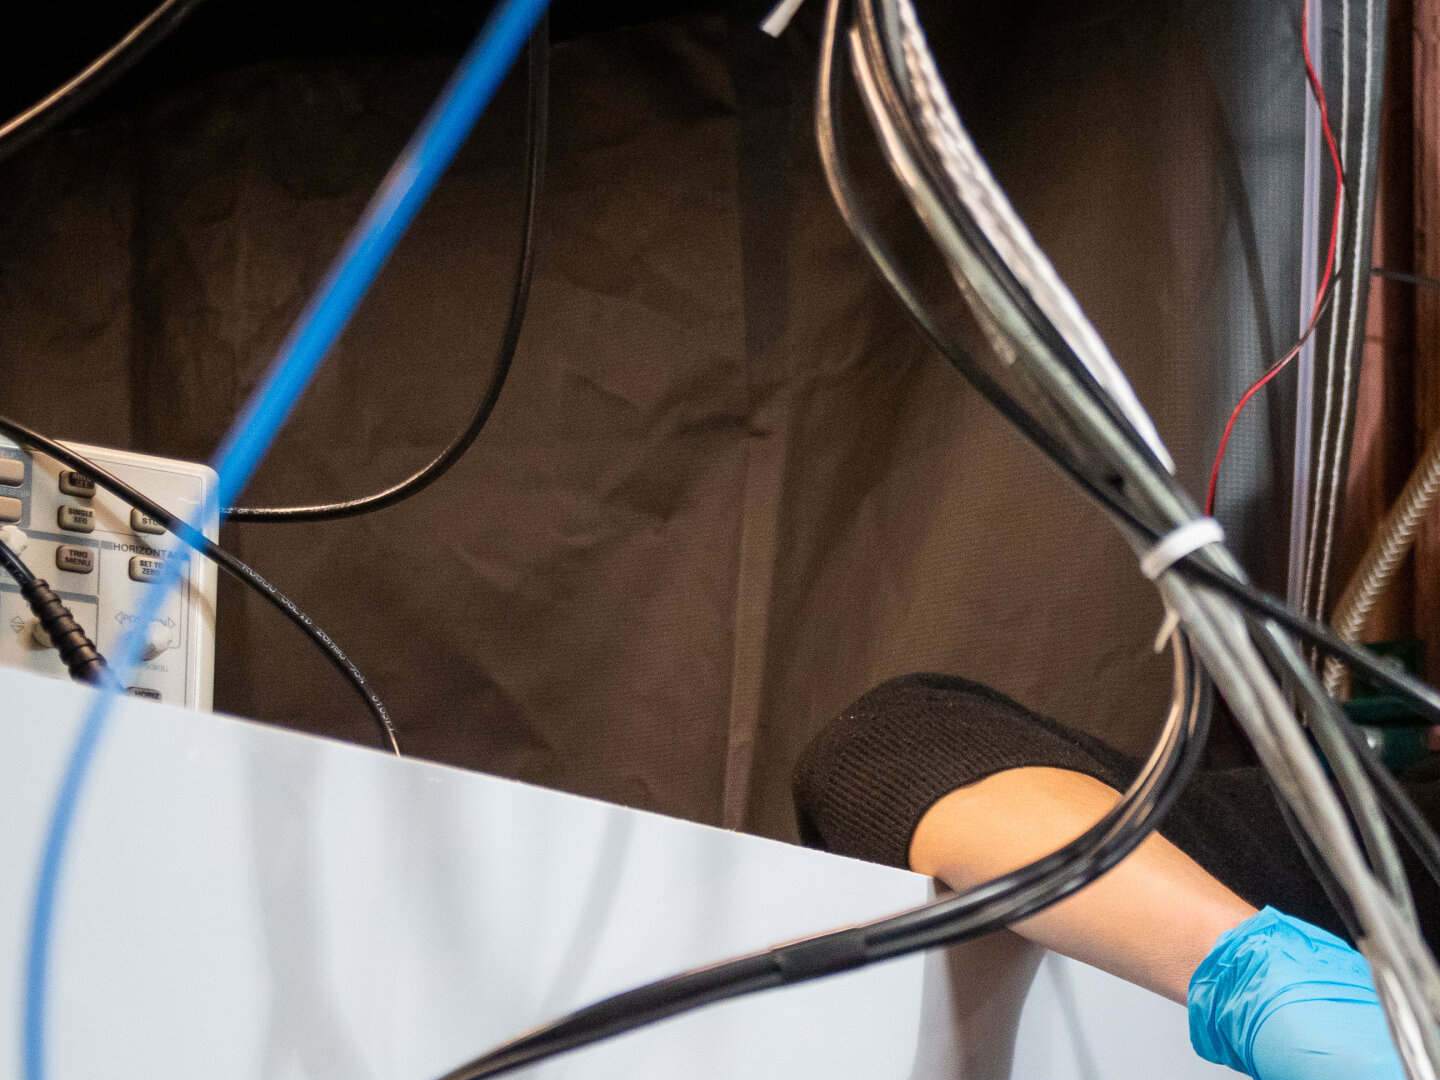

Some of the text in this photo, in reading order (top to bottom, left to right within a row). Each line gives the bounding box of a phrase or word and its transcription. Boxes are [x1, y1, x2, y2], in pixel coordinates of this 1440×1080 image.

[68, 507, 93, 517] SINGLE
[69, 549, 88, 559] TRIG
[113, 542, 177, 559] HORIZONTA
[65, 557, 90, 567] MENU
[140, 560, 152, 568] SET
